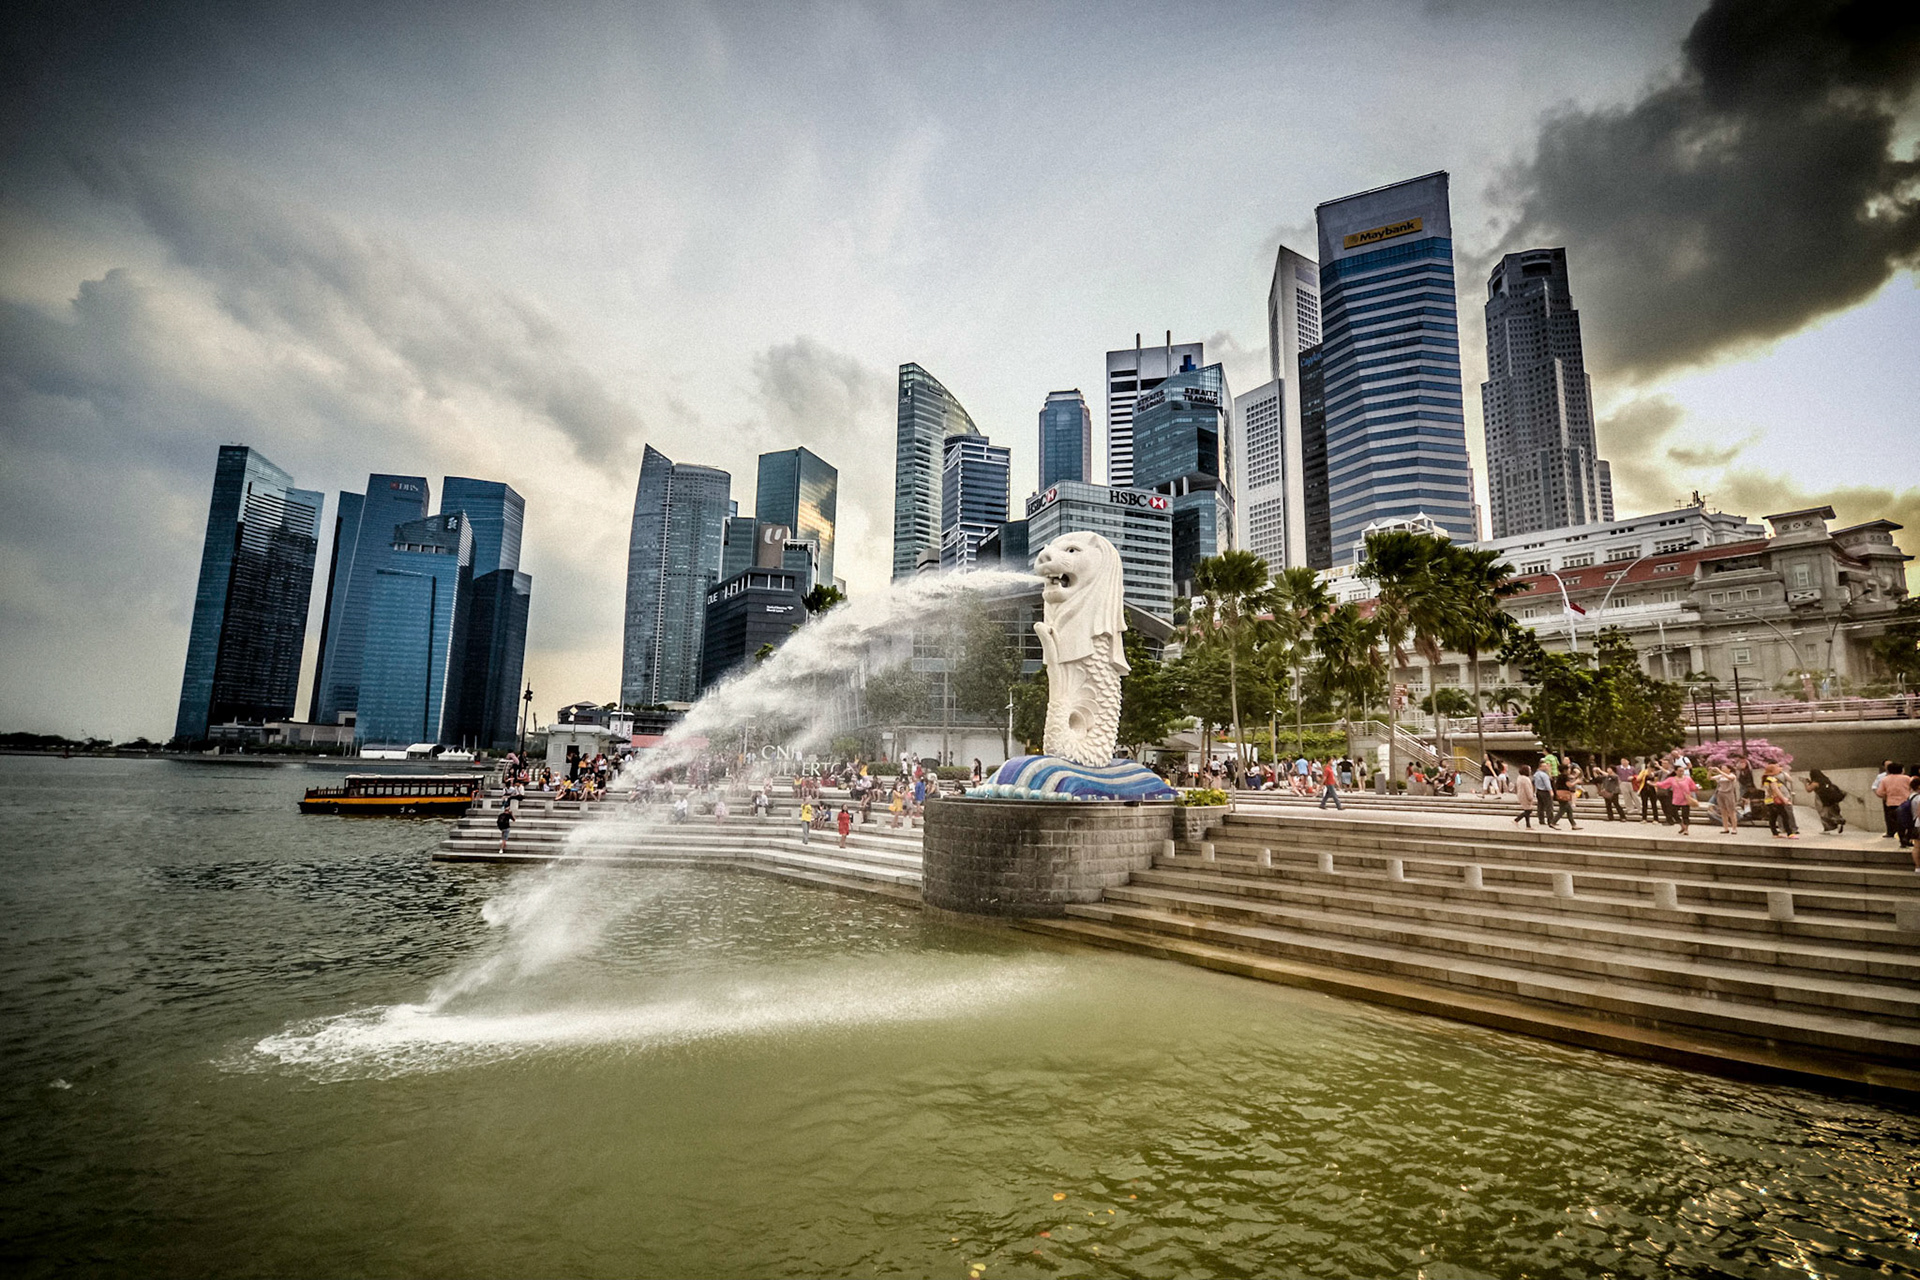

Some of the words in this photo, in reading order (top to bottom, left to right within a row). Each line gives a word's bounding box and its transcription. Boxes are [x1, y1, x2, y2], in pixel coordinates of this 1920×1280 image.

[1360, 222, 1415, 242] Maybank
[1137, 389, 1165, 407] STRAITS
[1185, 387, 1218, 397] STRAITS
[1183, 394, 1218, 405] TRADING
[399, 483, 419, 492] DBS
[1027, 494, 1047, 516] HSBC
[1109, 490, 1147, 507] HSBC
[1324, 568, 1344, 578] THE
